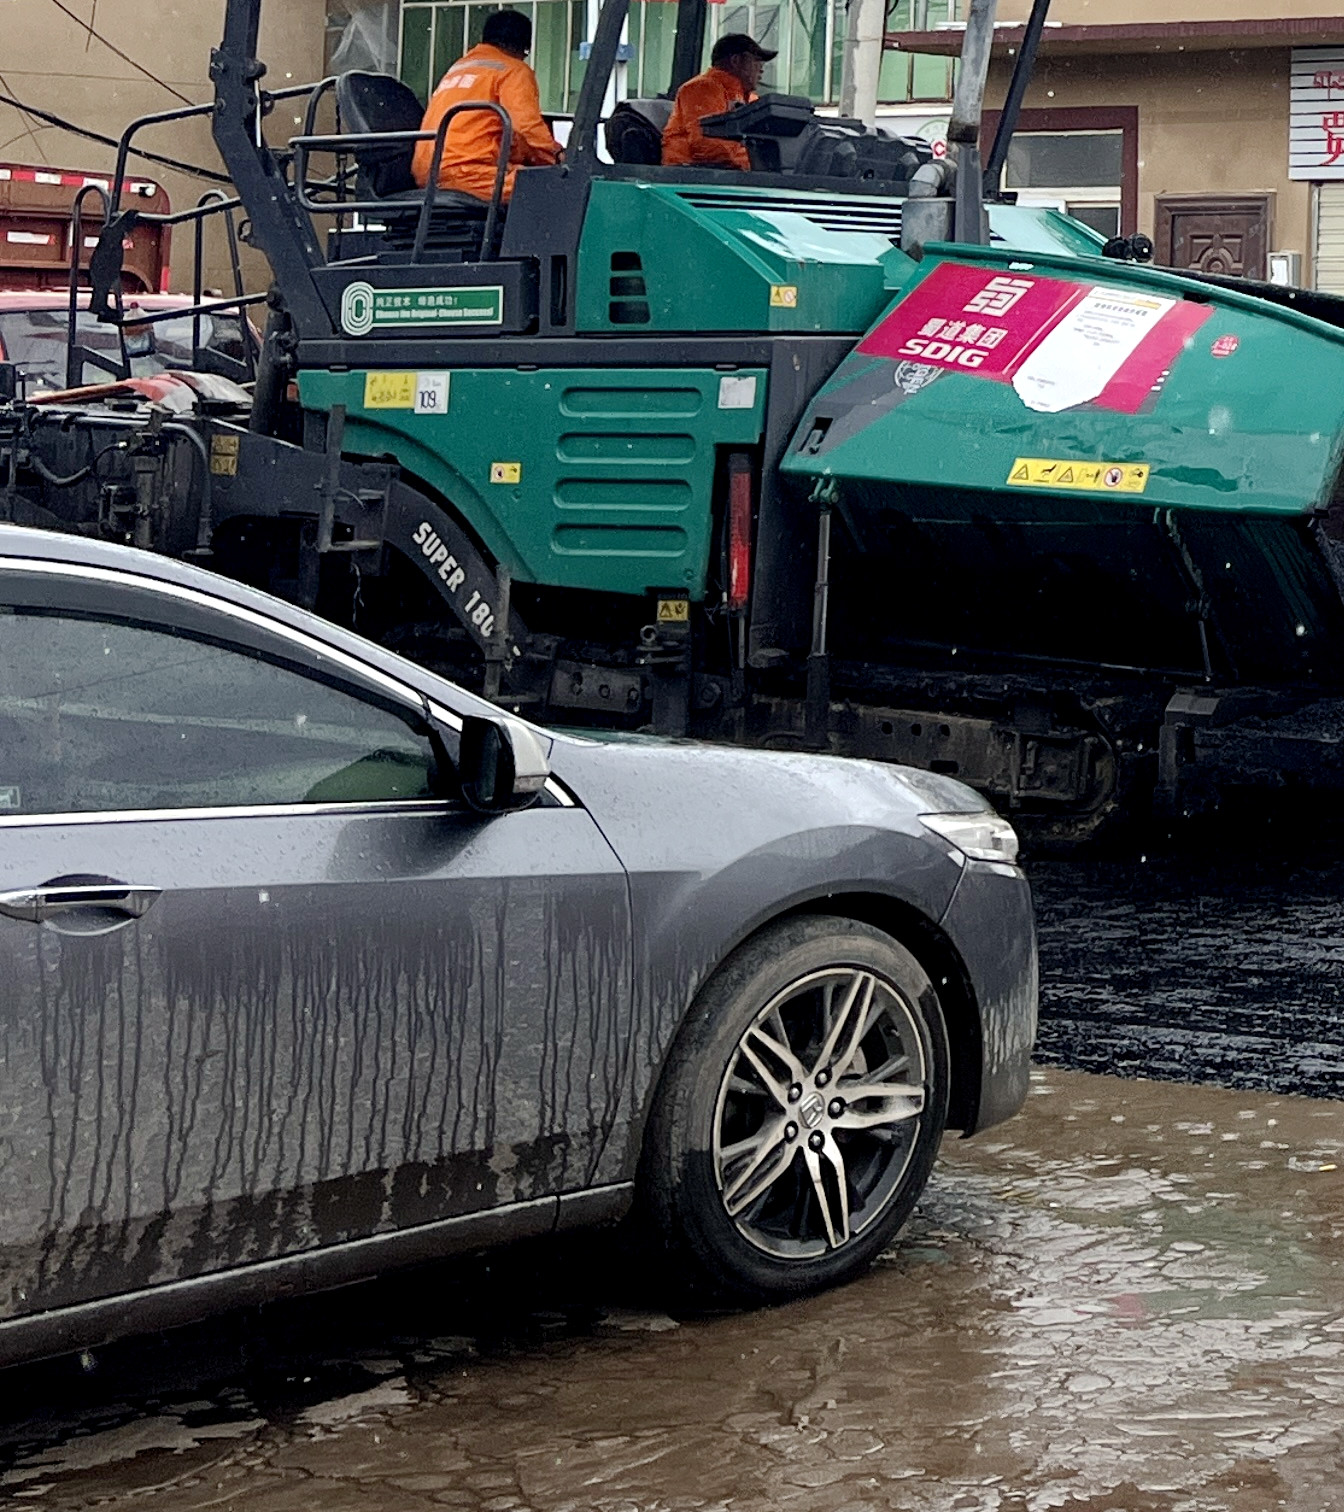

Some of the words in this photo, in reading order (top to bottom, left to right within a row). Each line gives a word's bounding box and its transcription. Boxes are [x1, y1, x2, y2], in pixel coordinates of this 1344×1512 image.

[917, 317, 1009, 349] 蜀道集团
[898, 338, 990, 368] SDIG
[412, 521, 465, 593] SUPER
